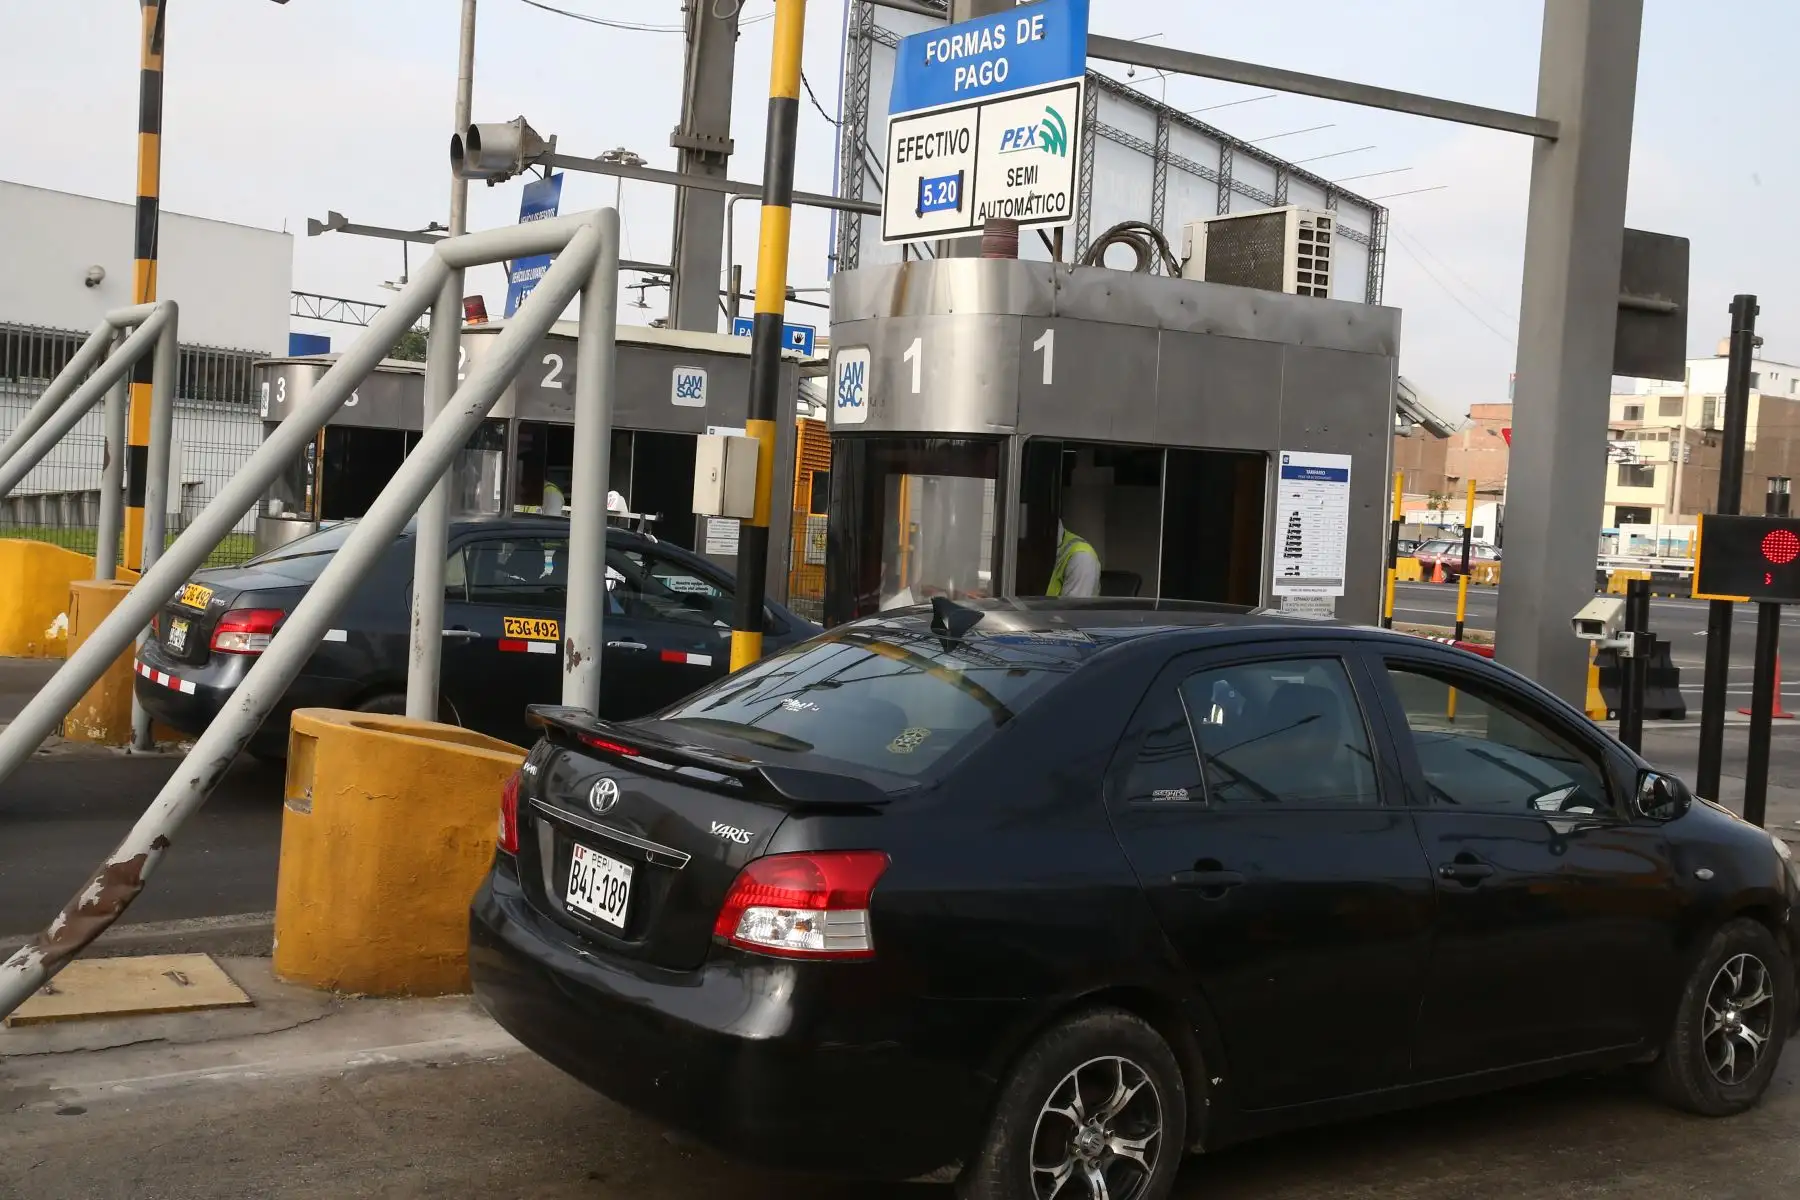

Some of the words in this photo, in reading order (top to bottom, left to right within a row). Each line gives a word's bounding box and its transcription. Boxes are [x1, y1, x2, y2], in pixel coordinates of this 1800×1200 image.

[925, 24, 1006, 63] FORMAS
[1016, 14, 1044, 45] DE
[954, 57, 1009, 91] PAGO
[897, 127, 970, 163] EFECTIVO
[1001, 124, 1039, 150] PEX
[1007, 165, 1039, 187] SEMI
[923, 180, 957, 206] 5.20
[541, 353, 563, 389] 2
[903, 337, 922, 393] 1
[1033, 328, 1054, 384] 1
[677, 374, 702, 387] LAM
[839, 361, 864, 385] LAM
[277, 377, 285, 402] 3
